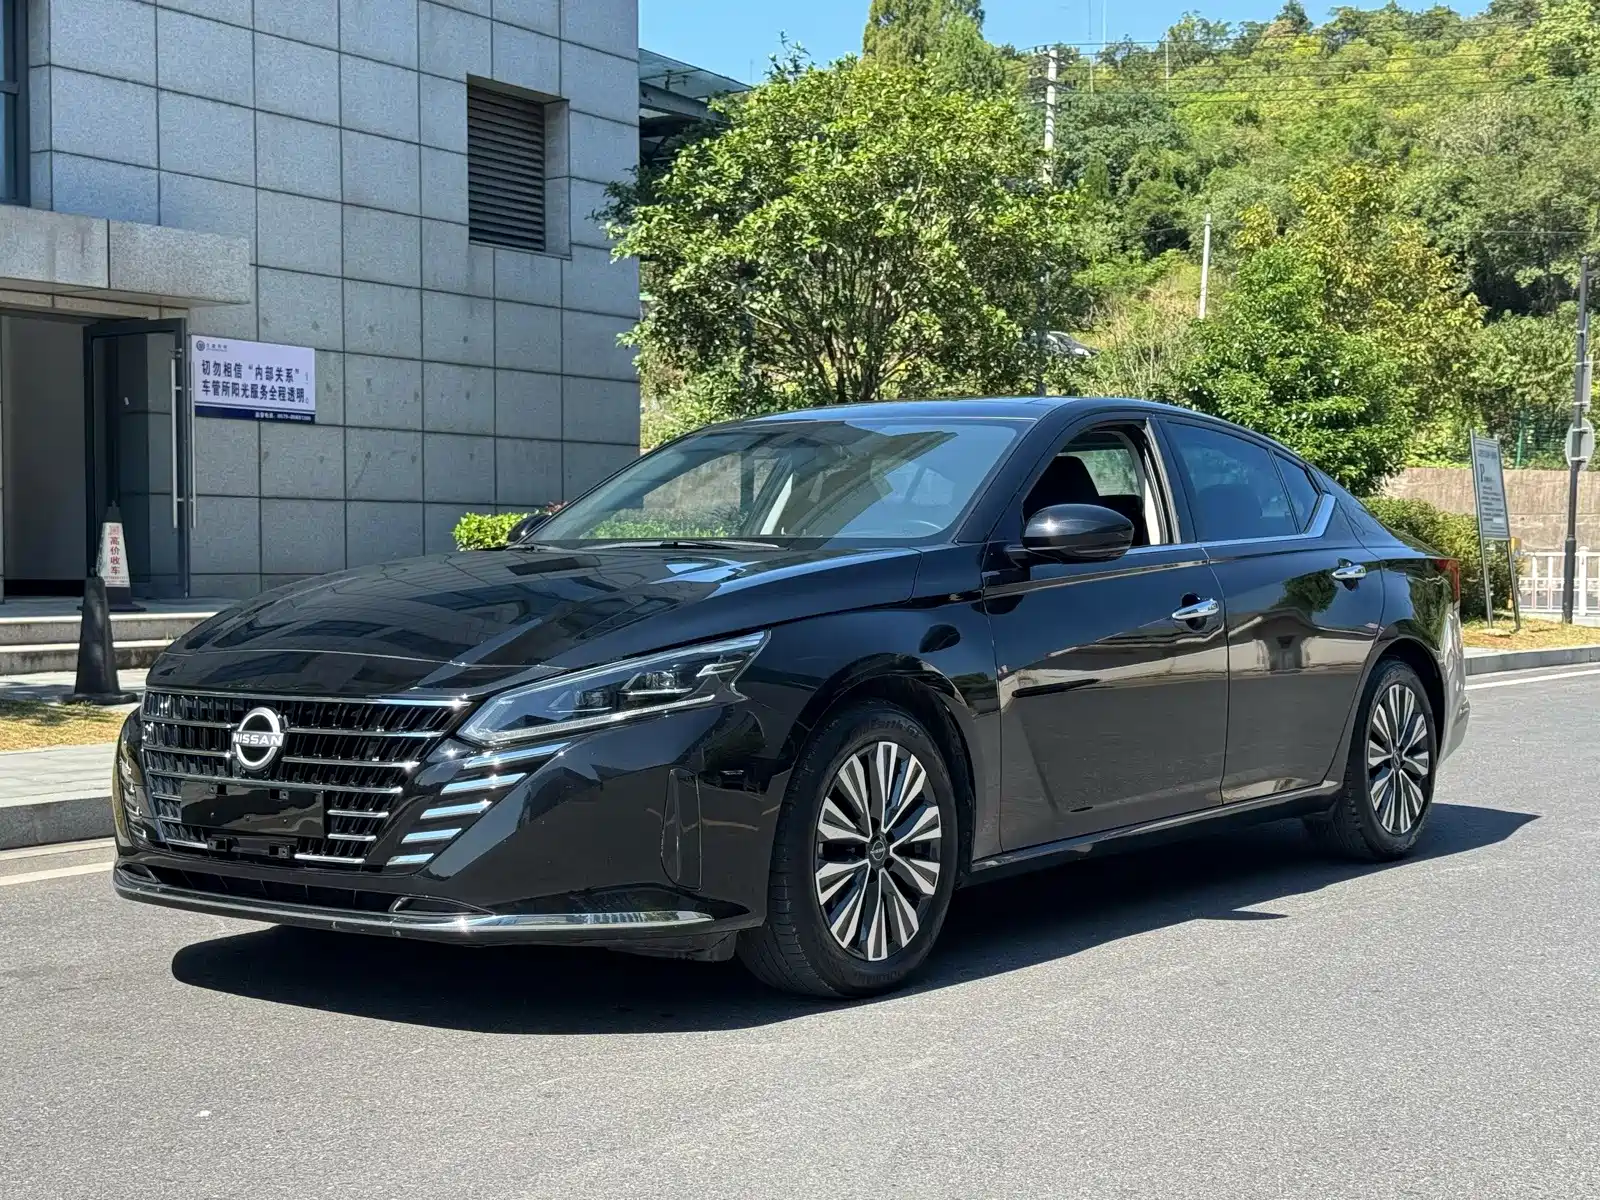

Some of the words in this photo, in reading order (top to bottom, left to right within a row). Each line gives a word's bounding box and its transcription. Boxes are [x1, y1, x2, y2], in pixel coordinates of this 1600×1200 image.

[110, 536, 120, 575] 高价收车
[233, 732, 282, 746] NISSAN
